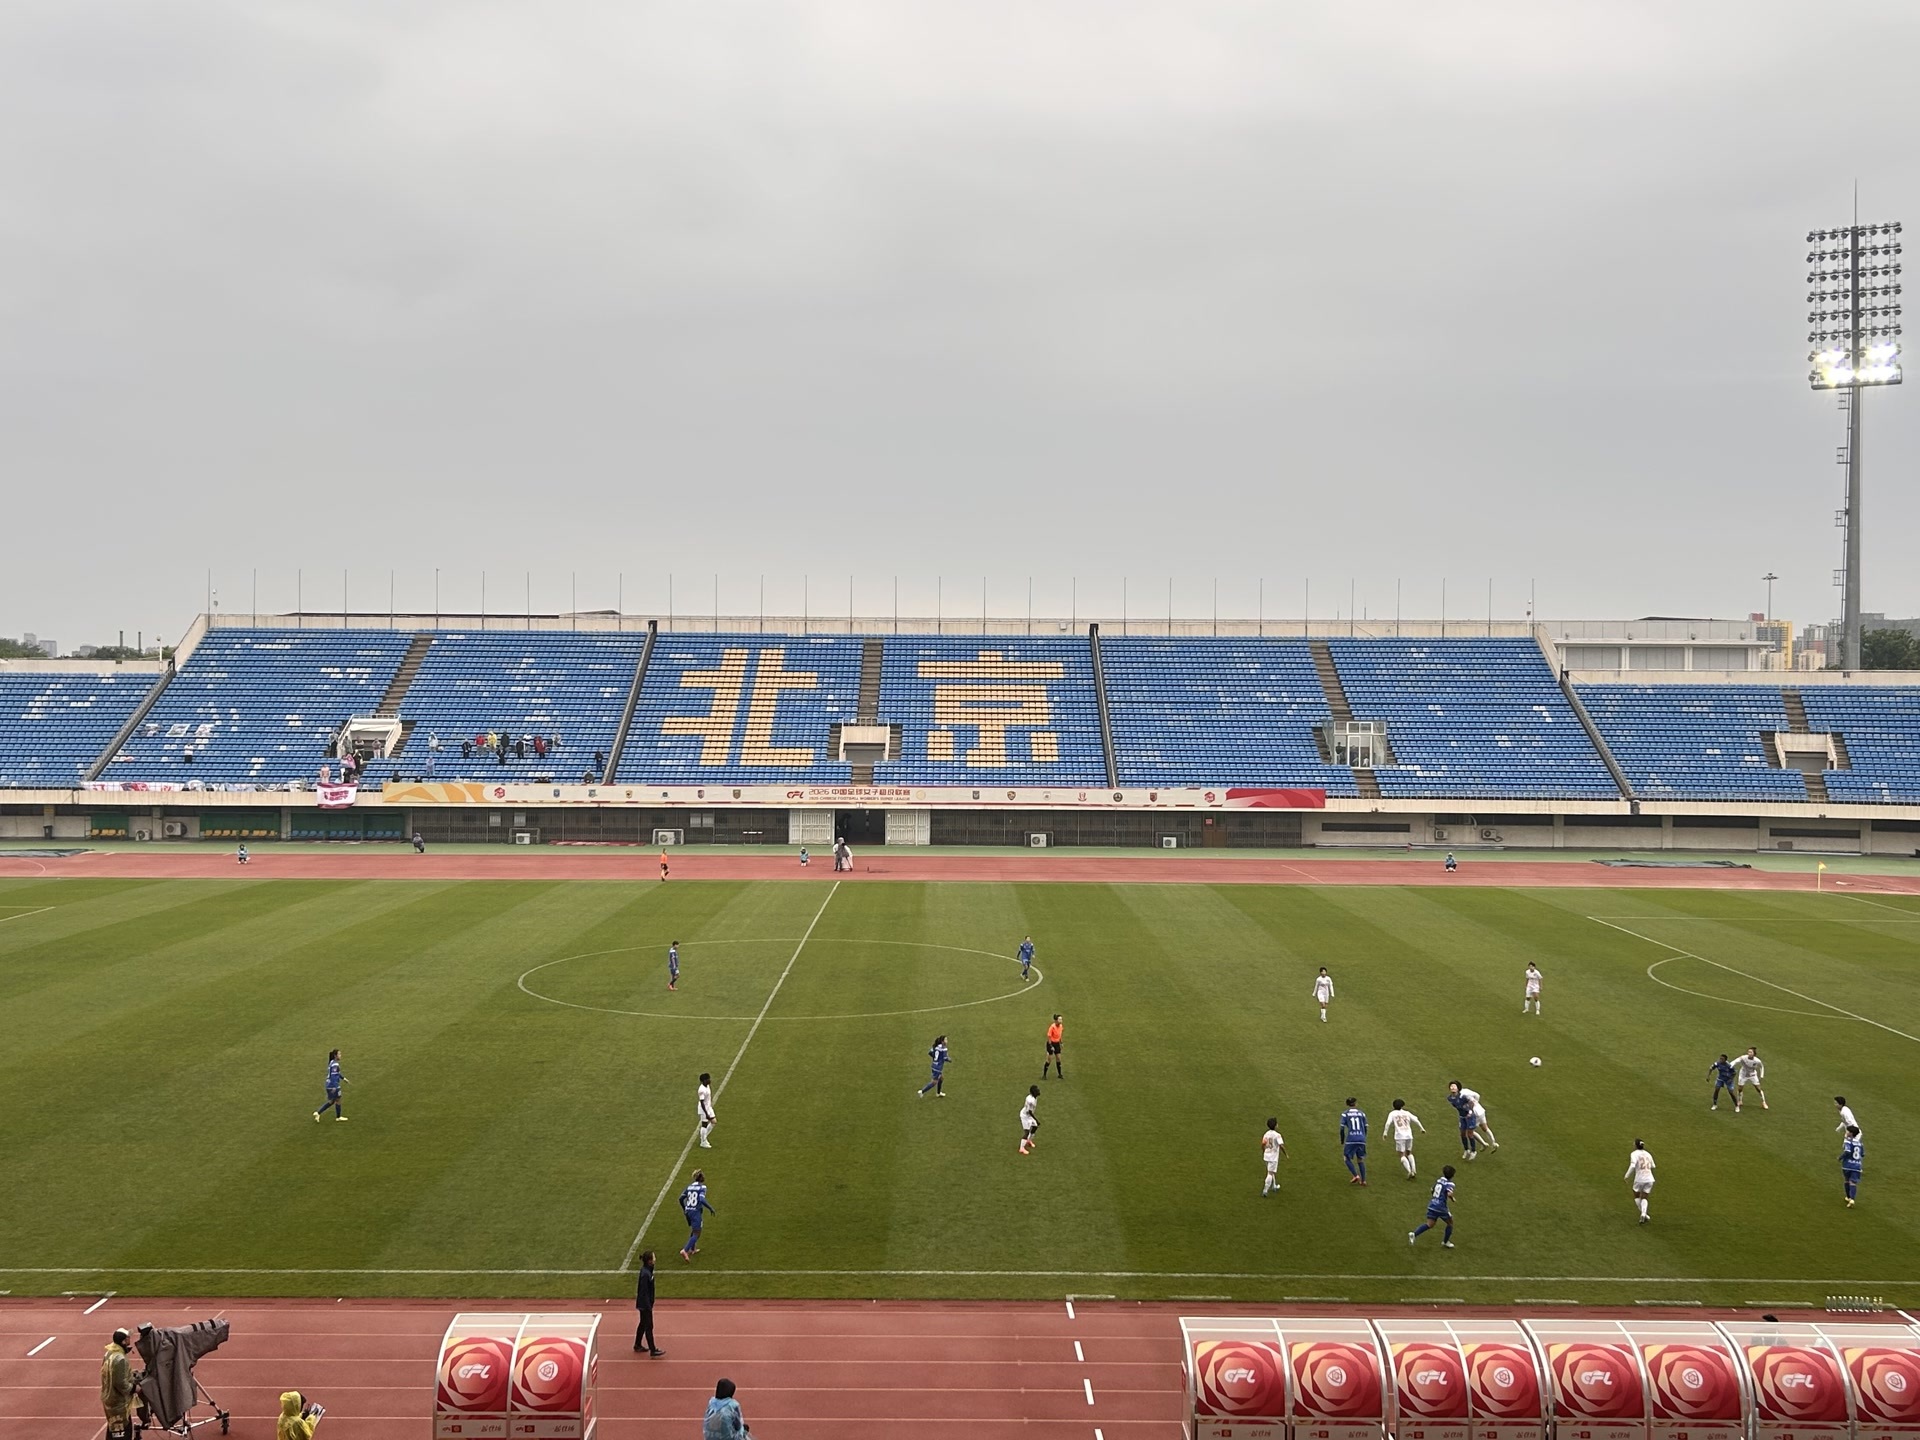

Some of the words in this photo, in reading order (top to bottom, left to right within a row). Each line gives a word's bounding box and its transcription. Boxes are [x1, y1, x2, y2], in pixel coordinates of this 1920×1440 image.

[661, 648, 1064, 768] 北京
[786, 791, 804, 799] CFL
[1350, 1117, 1360, 1130] 11
[1853, 1147, 1860, 1160] 8
[686, 1191, 698, 1207] 38
[458, 1363, 491, 1379] CFL
[1224, 1367, 1256, 1383] CFL
[1416, 1369, 1448, 1385] CFL
[1581, 1370, 1613, 1386] CFL
[1781, 1373, 1815, 1388] CFL
